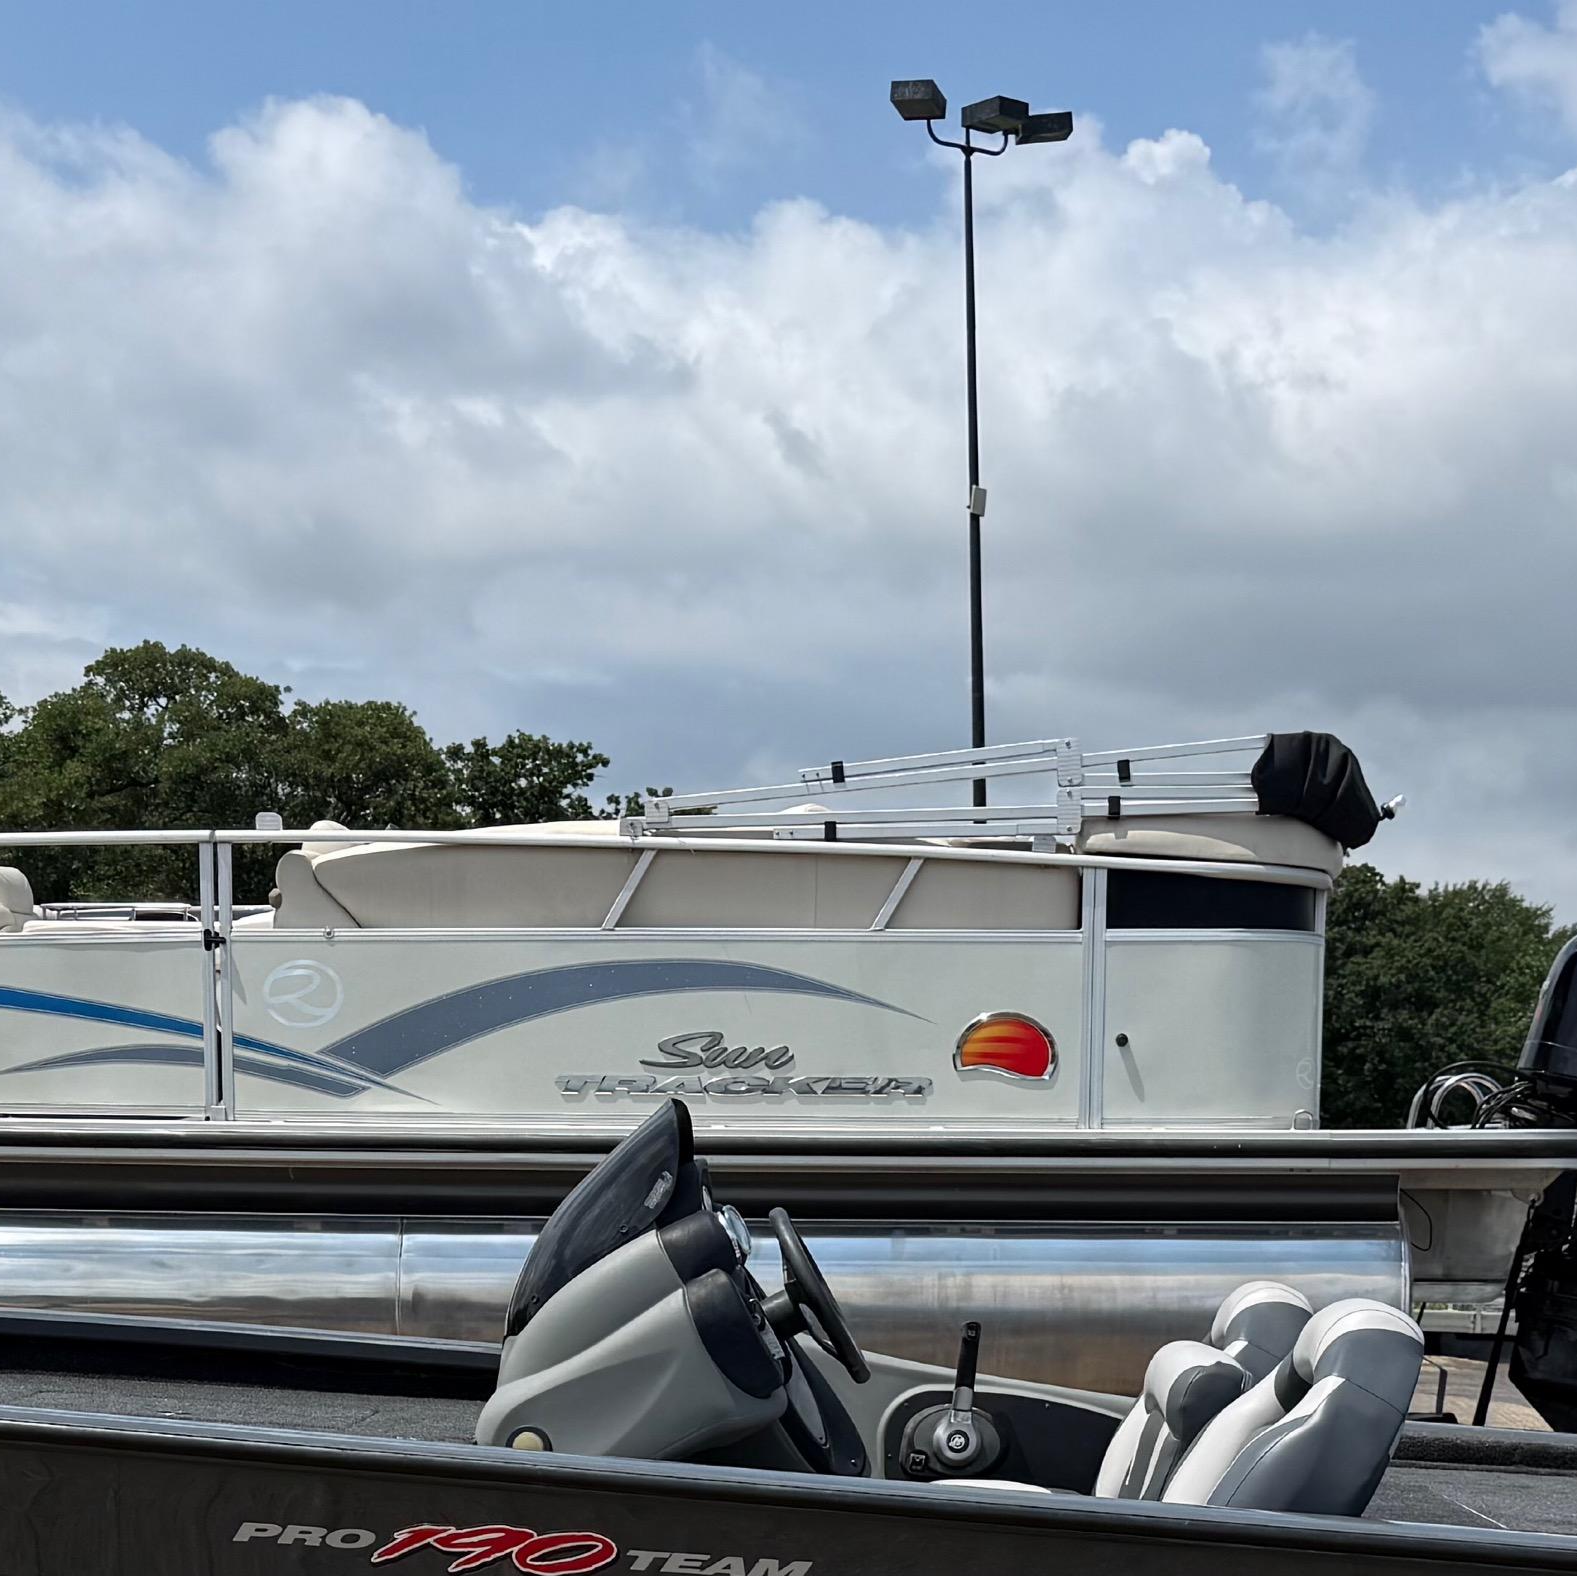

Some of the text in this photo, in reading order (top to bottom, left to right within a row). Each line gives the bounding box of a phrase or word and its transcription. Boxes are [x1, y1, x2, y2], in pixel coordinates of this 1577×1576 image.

[639, 1030, 795, 1070] Sun
[555, 1074, 933, 1098] TRACKER
[232, 1521, 376, 1550] PRO
[370, 1524, 618, 1576] 190
